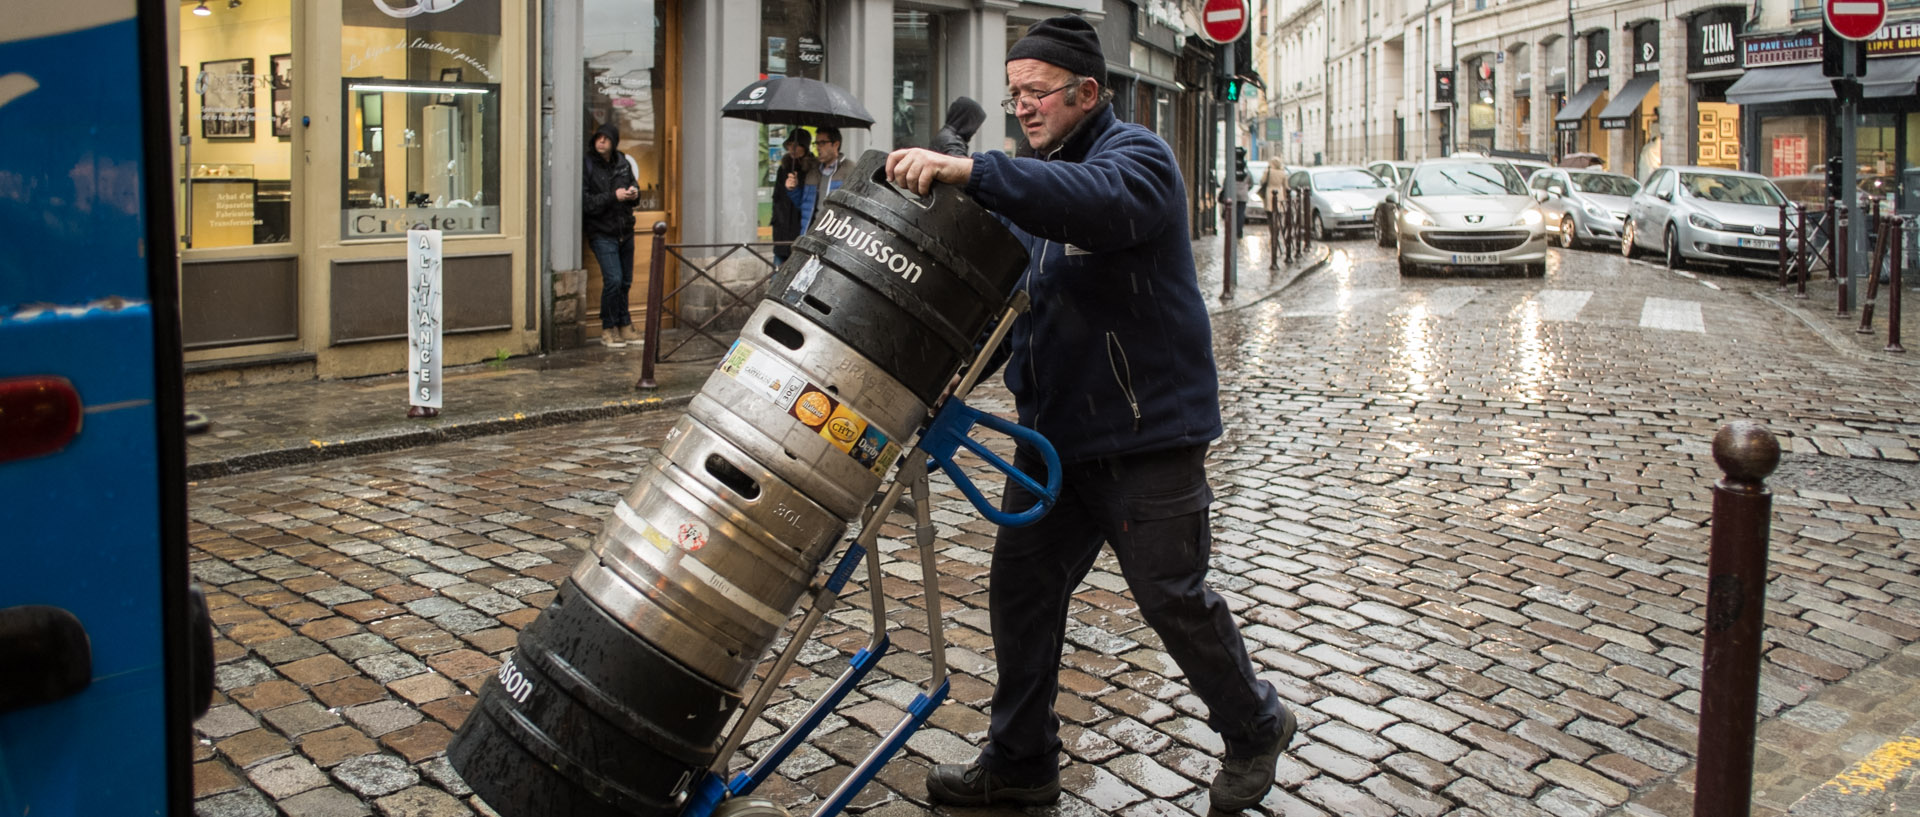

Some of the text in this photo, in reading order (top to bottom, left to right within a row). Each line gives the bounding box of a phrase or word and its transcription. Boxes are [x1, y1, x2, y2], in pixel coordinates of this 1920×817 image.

[1702, 22, 1734, 54] ZEINA
[1748, 44, 1758, 52] AU
[1703, 54, 1735, 65] ALLIANCES
[209, 219, 263, 228] Transformation
[815, 208, 923, 285] Dubuisson
[419, 234, 430, 401] ALLIANCES
[858, 438, 879, 459] Derby
